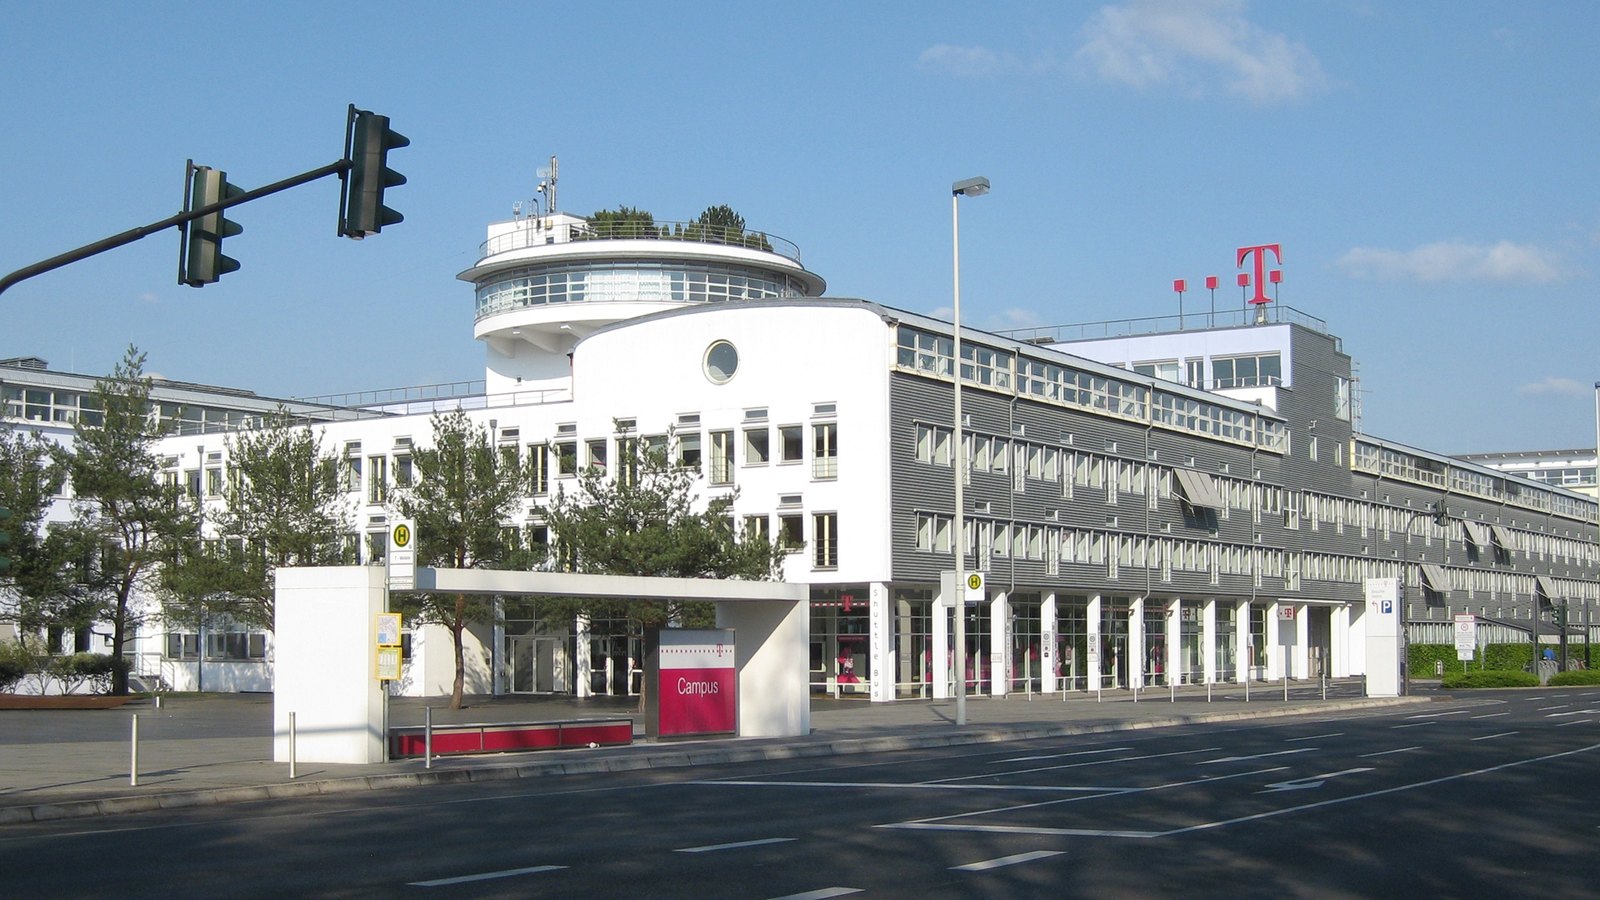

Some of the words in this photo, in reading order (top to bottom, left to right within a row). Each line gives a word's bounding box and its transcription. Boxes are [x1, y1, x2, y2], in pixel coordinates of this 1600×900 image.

[1236, 243, 1282, 304] T
[398, 529, 406, 542] H
[971, 577, 978, 587] H
[1383, 601, 1391, 613] P
[677, 676, 719, 698] Campus
